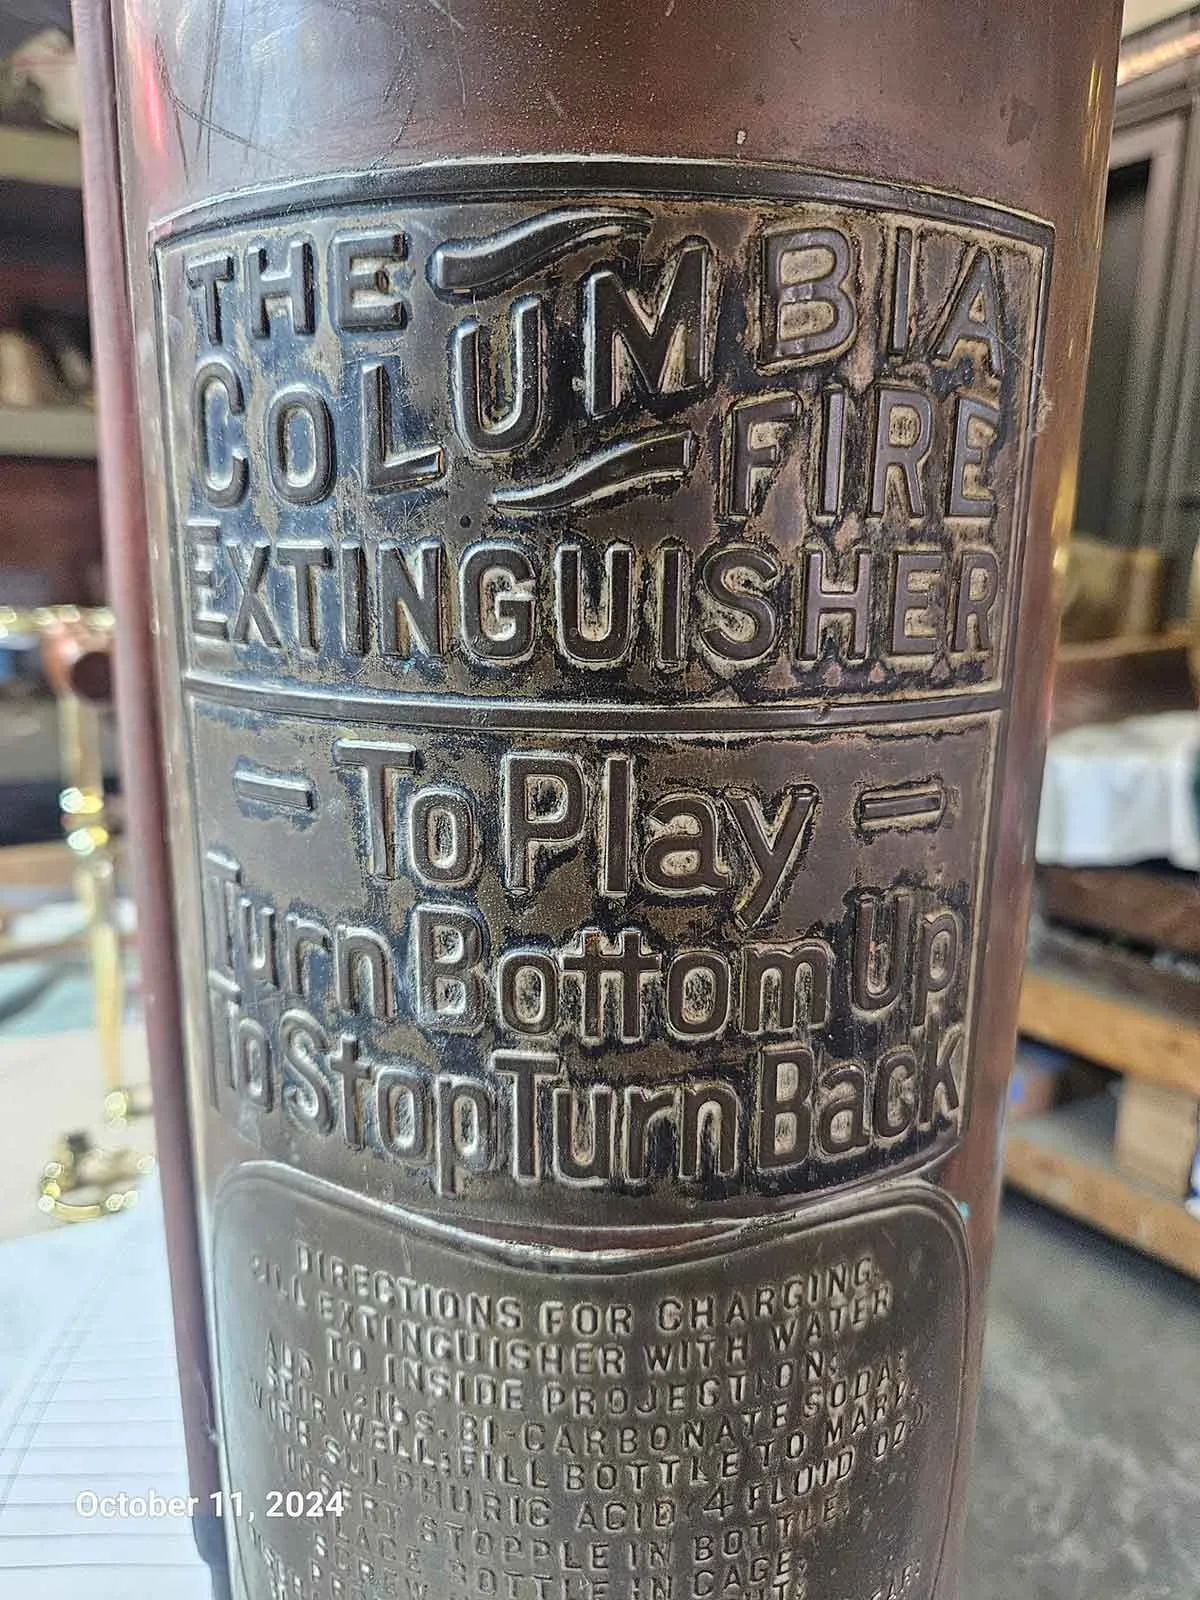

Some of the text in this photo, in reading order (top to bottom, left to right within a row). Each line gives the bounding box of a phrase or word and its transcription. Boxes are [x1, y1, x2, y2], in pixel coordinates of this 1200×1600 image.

[186, 227, 408, 347] THE
[193, 220, 1003, 507] COLUMBIA
[726, 380, 1001, 521] FIRE
[185, 517, 998, 667] EXTINGUISHER
[499, 750, 819, 929] Play
[204, 848, 962, 1042] Turn Bottom Up
[278, 1004, 497, 1199] Stop
[490, 1048, 740, 1188] Turn
[756, 1020, 961, 1171] Back
[296, 1240, 523, 1330] DIRECTIONS
[538, 1299, 633, 1338] FOR
[318, 1290, 626, 1374] EXTINGUISHER
[643, 1332, 751, 1374] WITH
[771, 1281, 892, 1352] WATER
[325, 1325, 367, 1377] TO
[382, 1350, 524, 1414] INSIDE
[458, 1445, 549, 1490] FILL
[563, 1447, 739, 1493] BOTTLE
[750, 1432, 808, 1470] TO
[573, 1494, 676, 1533] ACID
[747, 1446, 855, 1514] FLUID
[628, 1537, 672, 1571] IN
